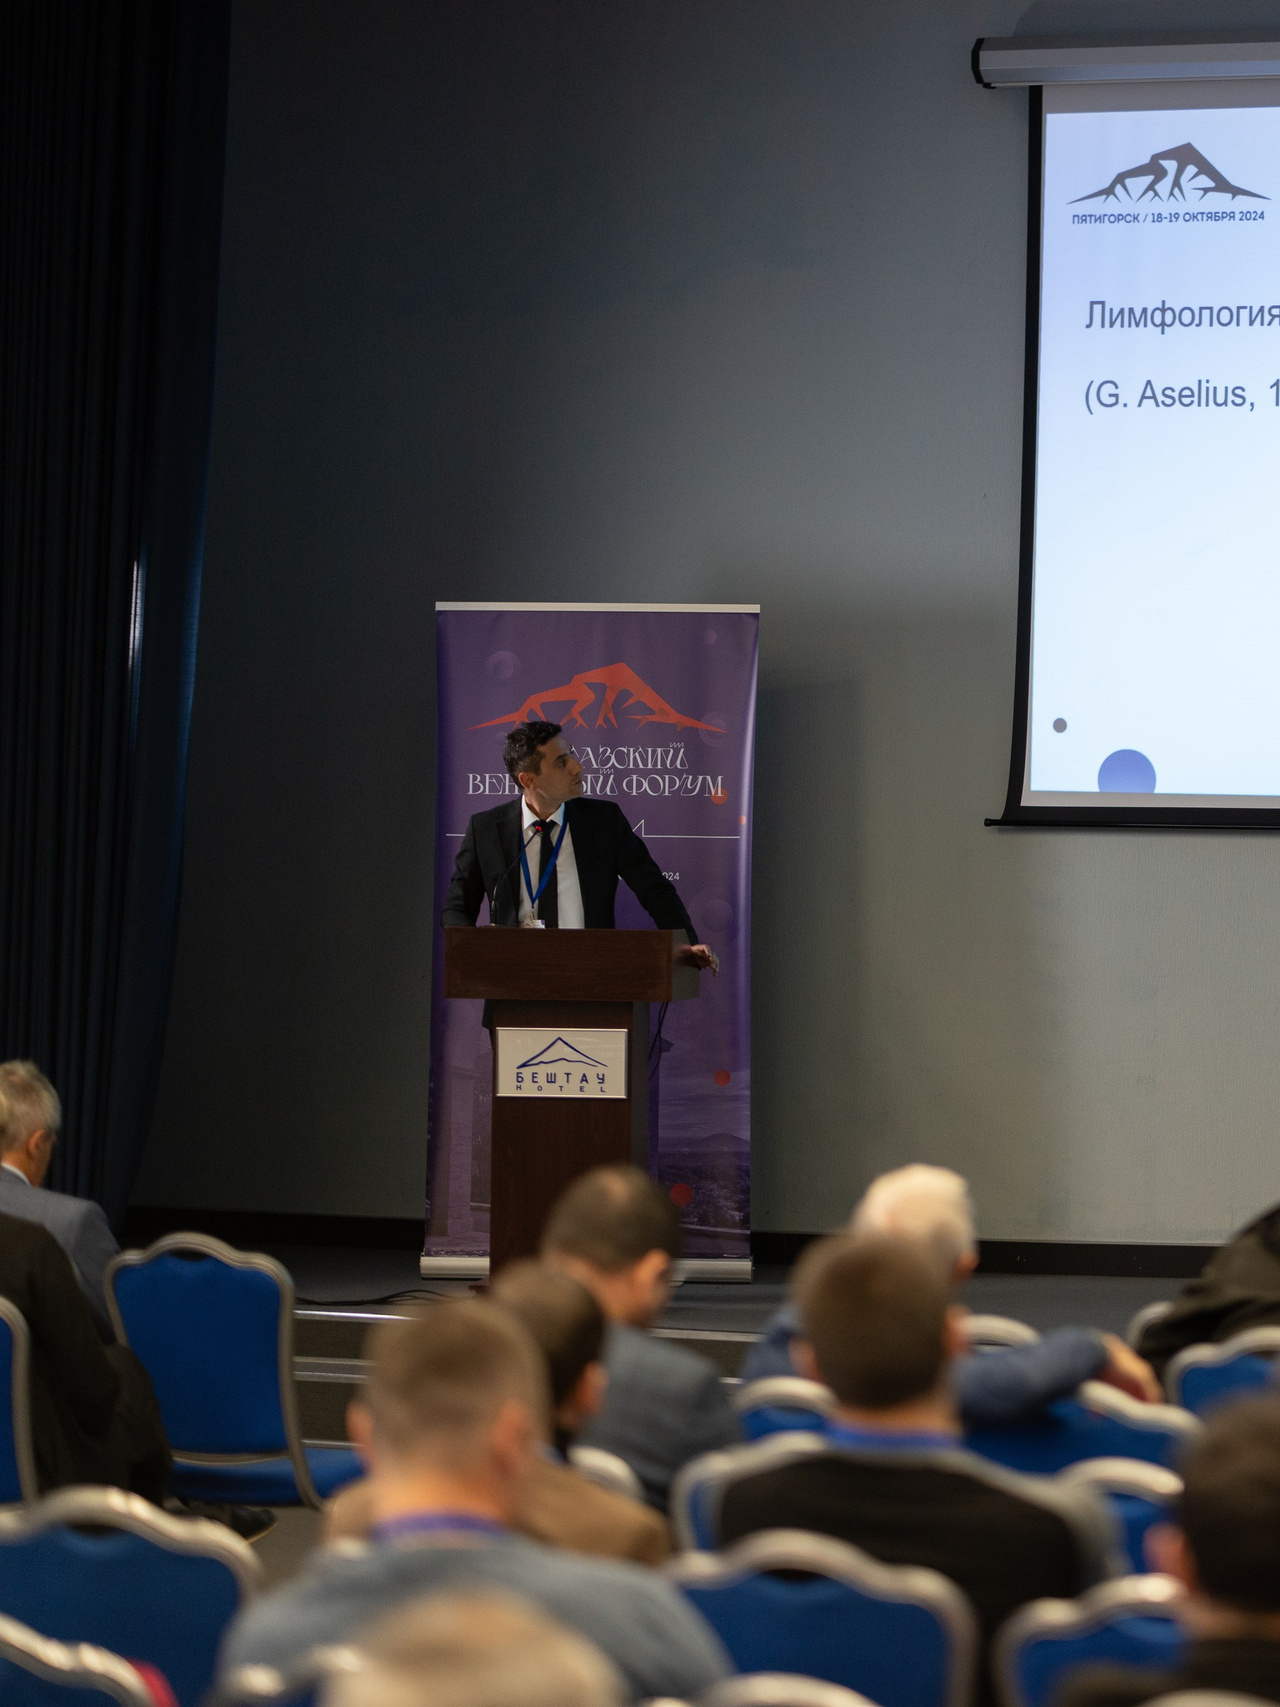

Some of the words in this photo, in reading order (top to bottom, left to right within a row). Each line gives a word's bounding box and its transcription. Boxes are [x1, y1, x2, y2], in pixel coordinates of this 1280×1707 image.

[1072, 213, 1141, 225] ПЯТИГОРСК
[1151, 212, 1181, 223] 18-19
[1182, 210, 1236, 223] ОКТЯБРЯ
[1238, 210, 1265, 222] 2024
[1084, 380, 1128, 415] (G.
[1137, 378, 1255, 411] Aselius,
[571, 742, 689, 770] АЗСКИЙ
[622, 773, 724, 797] ФОРУМ
[661, 871, 680, 881] 024
[516, 1071, 605, 1085] БЕШТАУ
[516, 1084, 606, 1093] HOTEL
